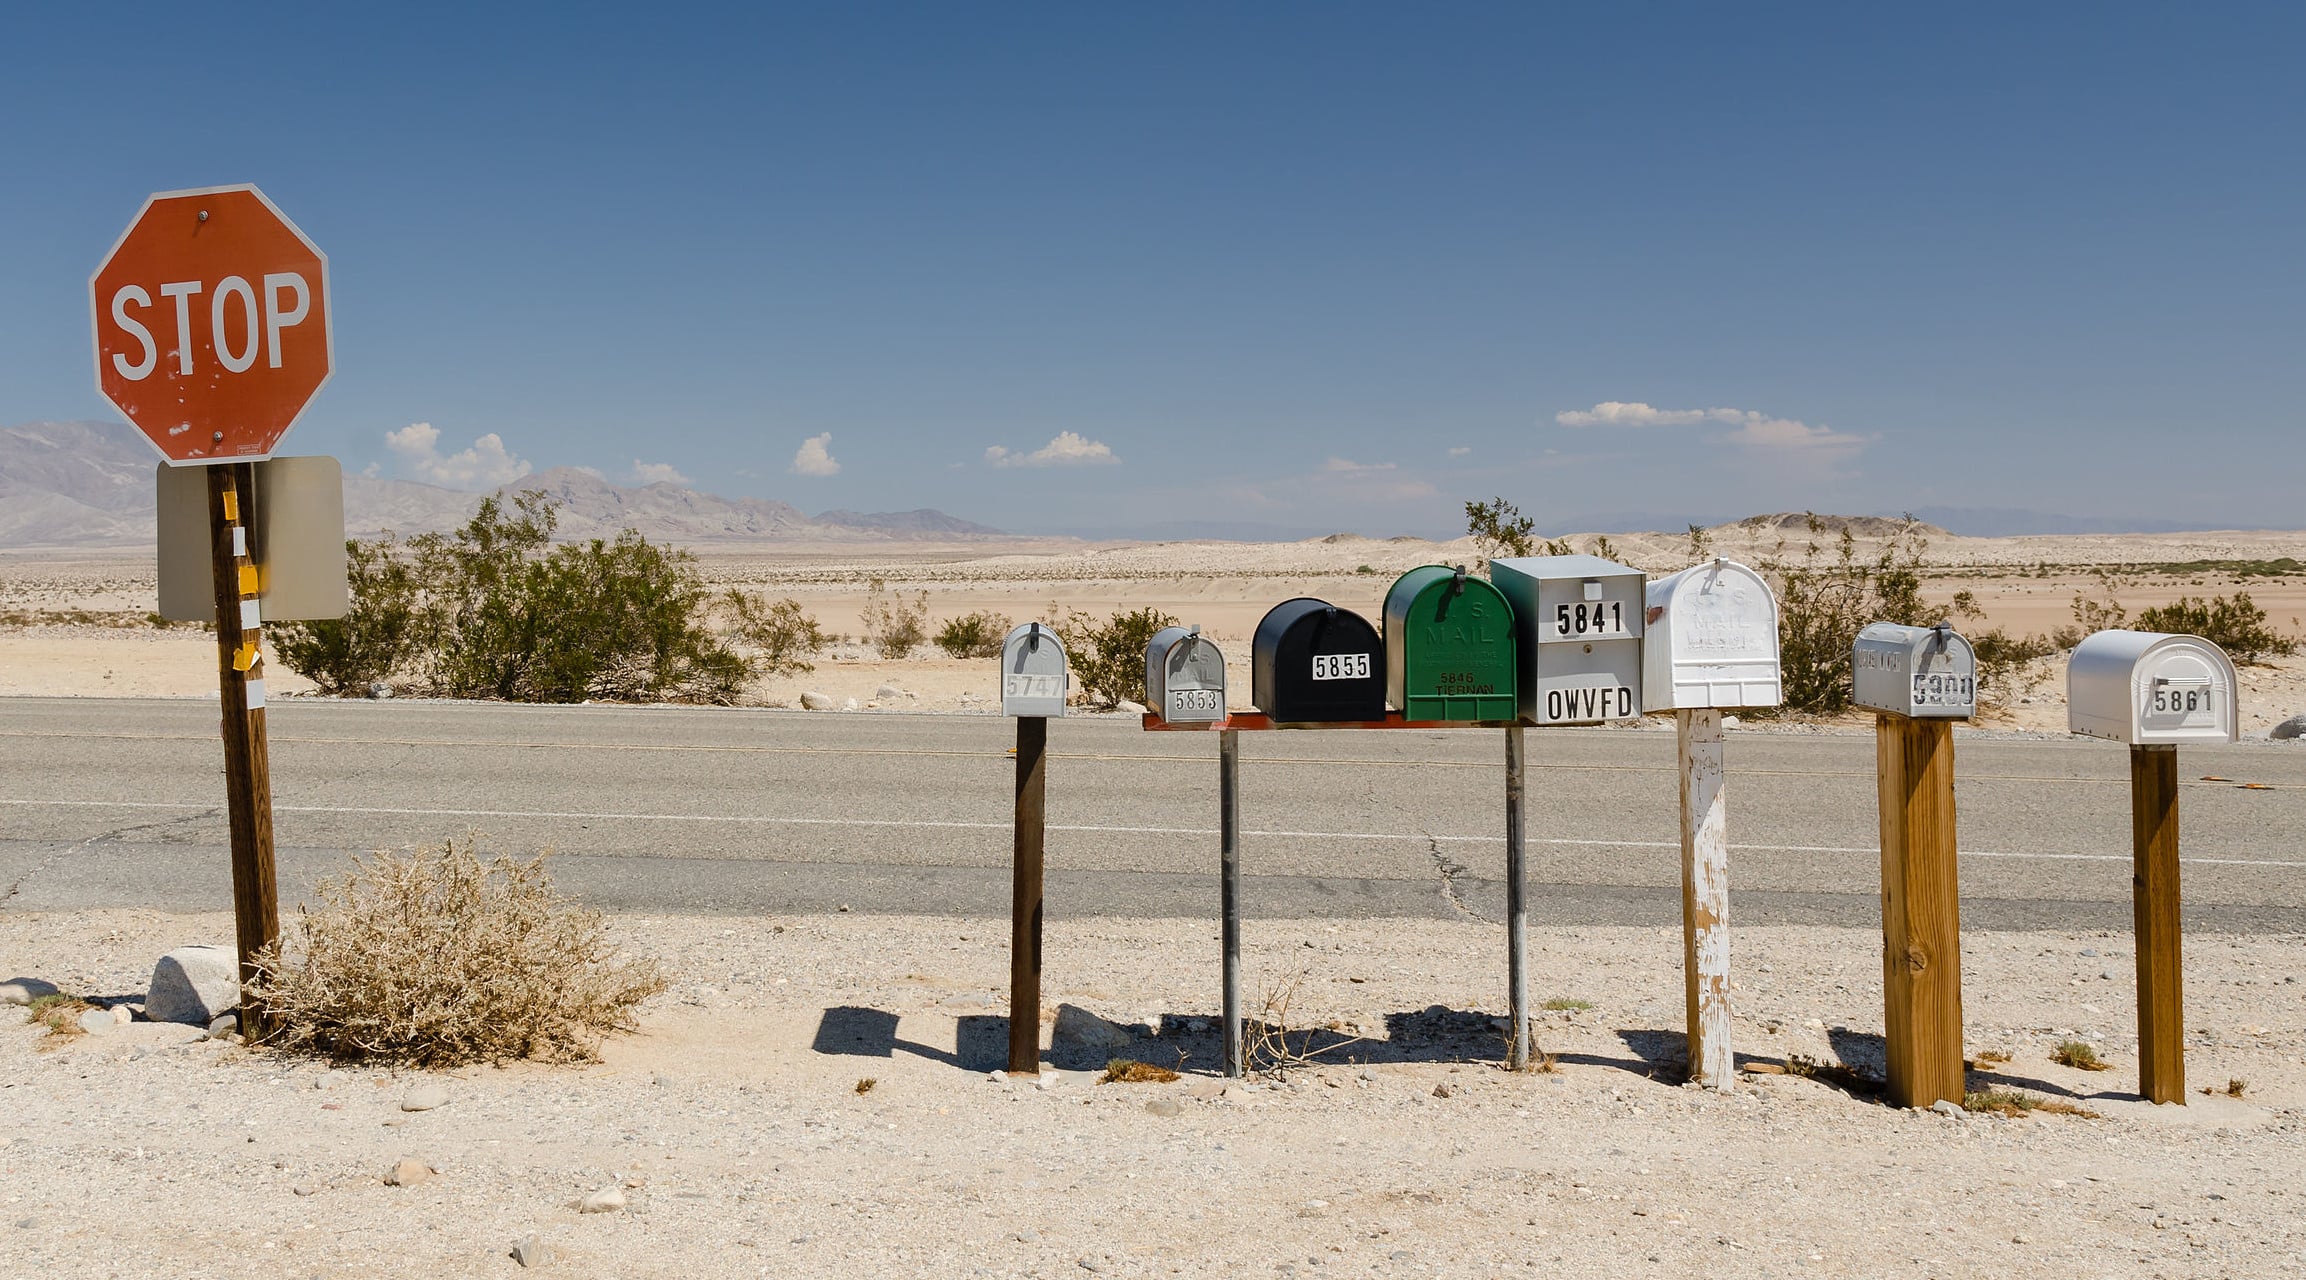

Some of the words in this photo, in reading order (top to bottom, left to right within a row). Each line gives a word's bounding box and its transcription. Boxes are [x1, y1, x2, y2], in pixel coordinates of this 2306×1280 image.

[111, 272, 311, 381] STOP
[1557, 602, 1622, 635] 5841
[1426, 626, 1494, 645] MAIL
[1316, 655, 1367, 678] 5855
[1006, 675, 1062, 697] 5747
[1435, 684, 1494, 697] TIERNAN
[1176, 691, 1217, 710] 5853
[1547, 686, 1633, 721] OWVFD
[2154, 690, 2212, 712] 5861
